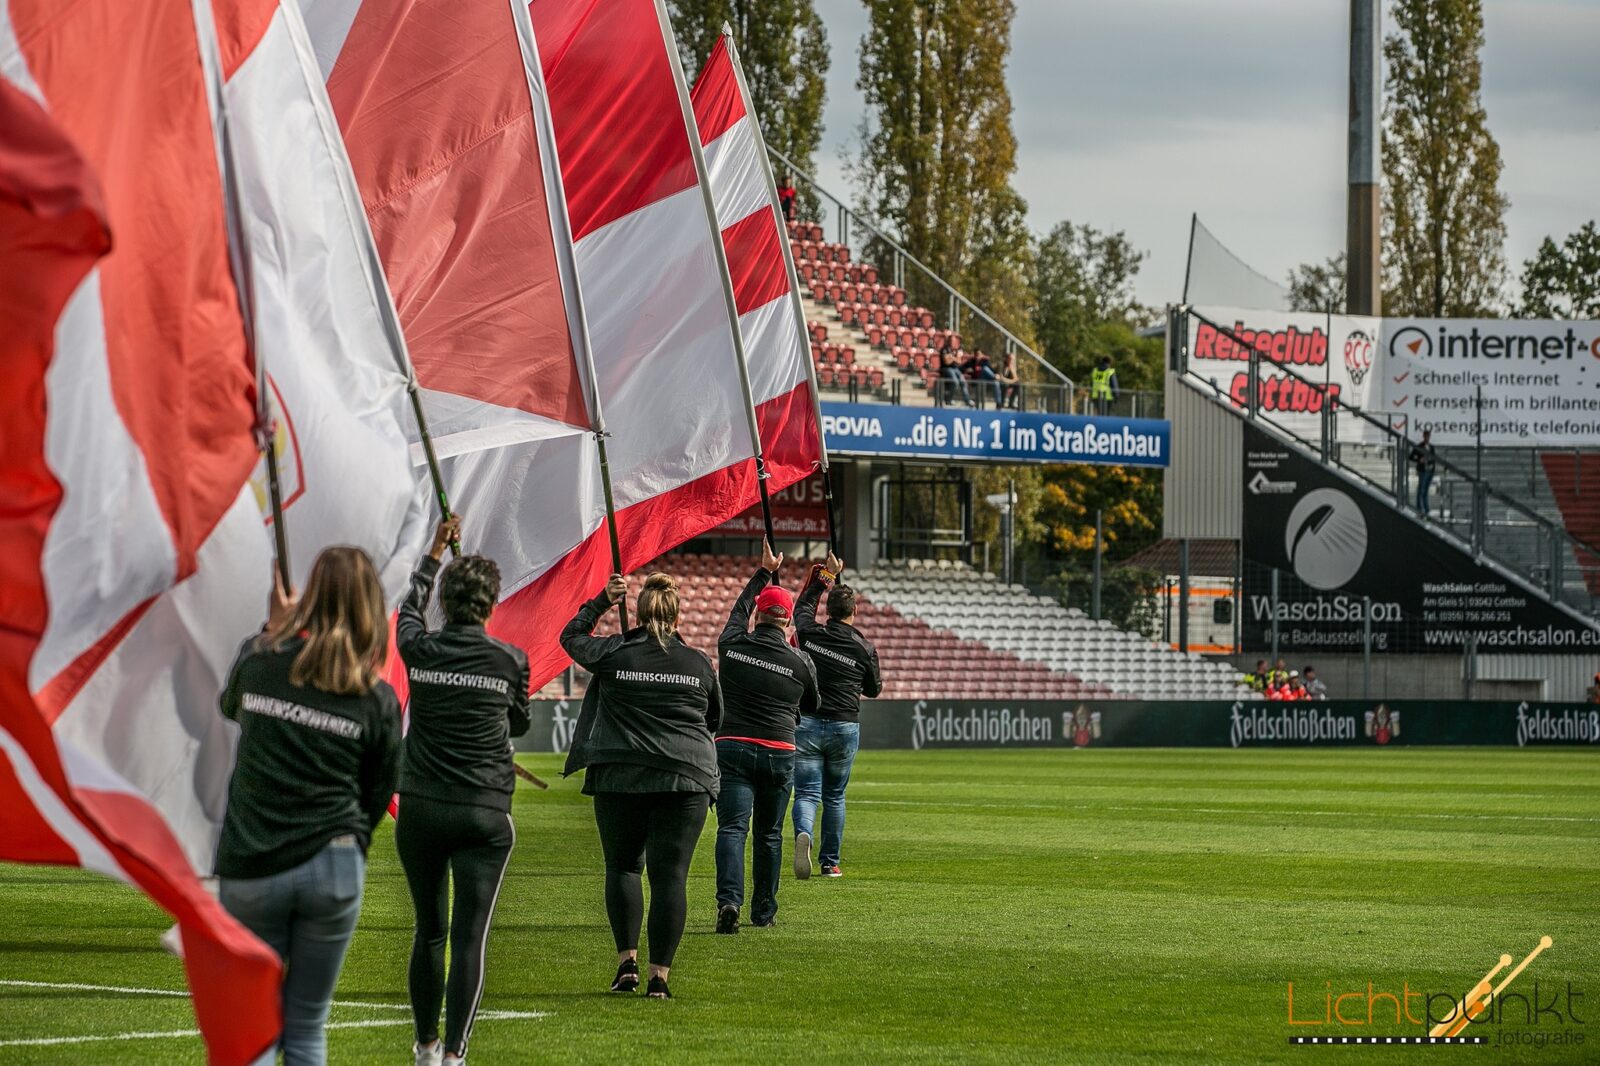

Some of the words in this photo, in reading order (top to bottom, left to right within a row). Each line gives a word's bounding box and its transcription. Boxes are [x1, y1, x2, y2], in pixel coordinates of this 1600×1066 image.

[1195, 320, 1328, 366] Reiseclub
[1344, 341, 1371, 368] RCC
[1414, 371, 1489, 386] schnelles
[1494, 371, 1560, 386] Internet
[1414, 395, 1499, 410] Fernsehen
[1504, 395, 1524, 410] im
[953, 417, 984, 449] Nr.
[989, 419, 1004, 450] 1
[1009, 420, 1037, 451] im
[1041, 421, 1161, 458] Straßenbau
[1414, 418, 1529, 437] kostengünstig
[1423, 582, 1473, 593] WaschSalon
[1474, 582, 1507, 593] Cottbus
[1494, 596, 1527, 608] Cottbus
[726, 649, 794, 677] FAHNENSCHWENKER
[804, 640, 856, 668] FAHNENSCHWENKER
[410, 667, 509, 694] FAHNENSCHWENKER
[615, 670, 700, 688] FAHNENSCHWENKER
